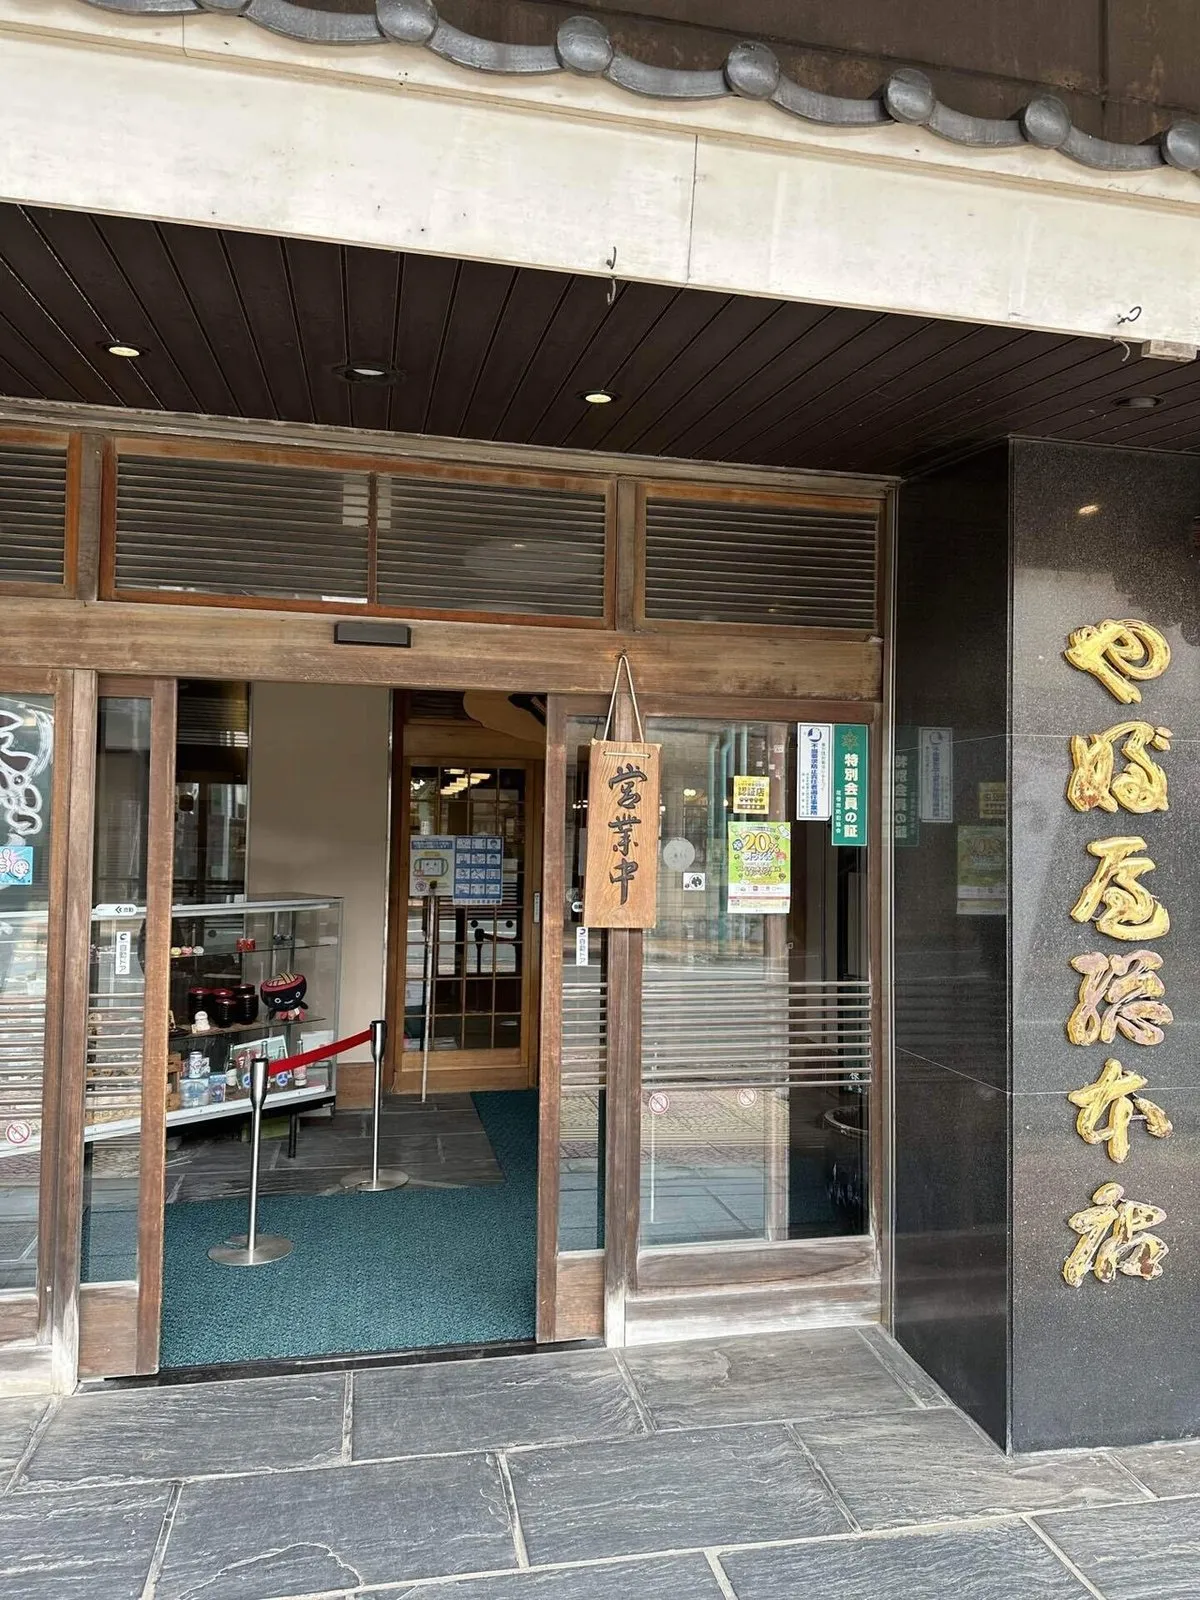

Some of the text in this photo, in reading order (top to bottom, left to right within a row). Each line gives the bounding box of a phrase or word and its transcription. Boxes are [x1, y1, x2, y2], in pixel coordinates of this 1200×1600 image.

[608, 763, 648, 906] 営業中
[844, 753, 859, 838] 特別会員の証
[740, 831, 781, 854] 20%
